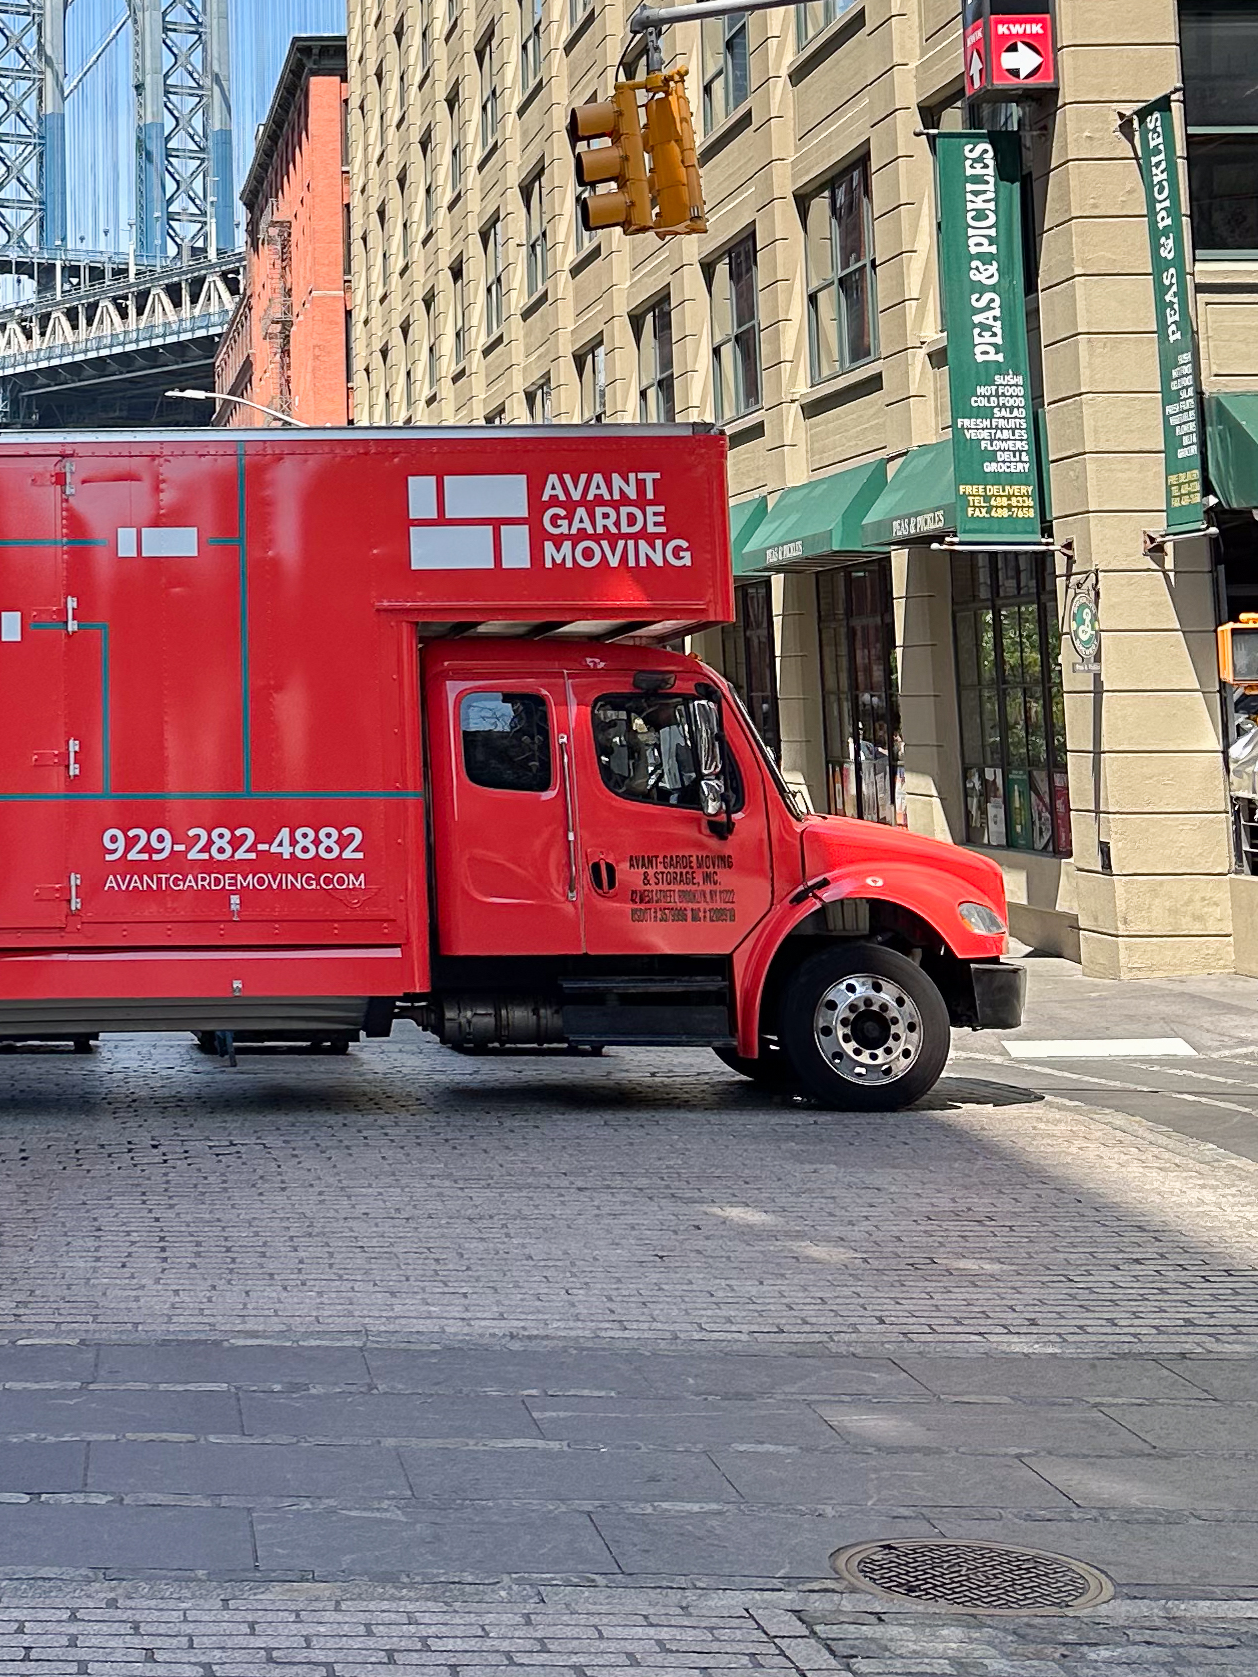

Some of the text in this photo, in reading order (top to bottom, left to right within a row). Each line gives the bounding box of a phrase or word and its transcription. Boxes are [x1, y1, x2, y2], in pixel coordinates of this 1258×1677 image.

[997, 23, 1044, 35] KWIK
[1147, 111, 1181, 343] PEAS & PICKLES
[964, 143, 1004, 363] PEAS & PICKLES
[994, 375, 1023, 384] SUSHI
[977, 386, 1024, 395] HOT FOOD
[971, 397, 1024, 406] COLD FOOD
[994, 408, 1026, 417] SALAD
[958, 419, 1027, 428] FRESH FRUITS
[964, 430, 1027, 439] VEGETABLES
[981, 441, 1028, 450] FLOWERS
[997, 452, 1029, 461] DELI &
[984, 463, 1030, 472] GROCERY
[542, 472, 661, 501] AVANT
[959, 485, 1034, 495] FREE DELIVERY
[543, 506, 666, 534] GARDE
[893, 510, 944, 536] PEAS & PICKLES
[544, 539, 692, 568] MOVING
[102, 827, 364, 861] 929-282-4882
[629, 855, 733, 870] AVANT-GARDE MOVING
[104, 873, 366, 891] AVANTGARDEMOVING.COM
[643, 871, 721, 887] & STORAGE, INC.
